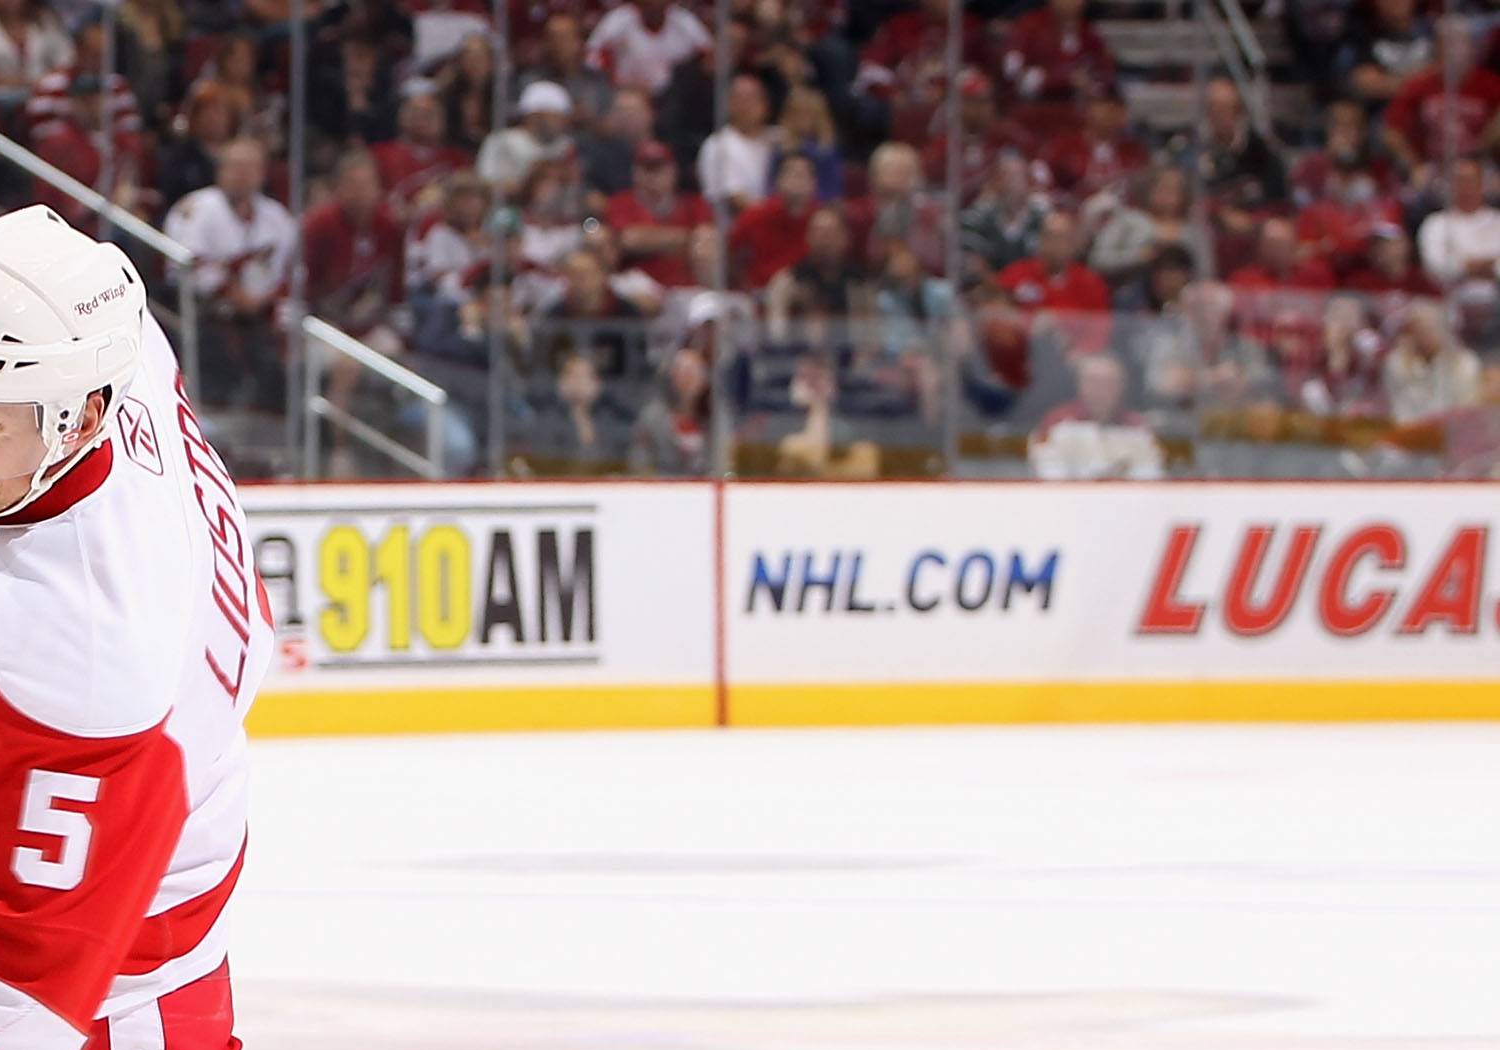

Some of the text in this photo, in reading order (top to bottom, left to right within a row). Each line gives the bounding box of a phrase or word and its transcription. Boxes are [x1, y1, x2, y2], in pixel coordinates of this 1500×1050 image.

[73, 283, 126, 315] Red Wings
[744, 547, 1062, 614] NHL.COM
[1134, 522, 1500, 638] LUCA
[12, 768, 102, 891] 5
